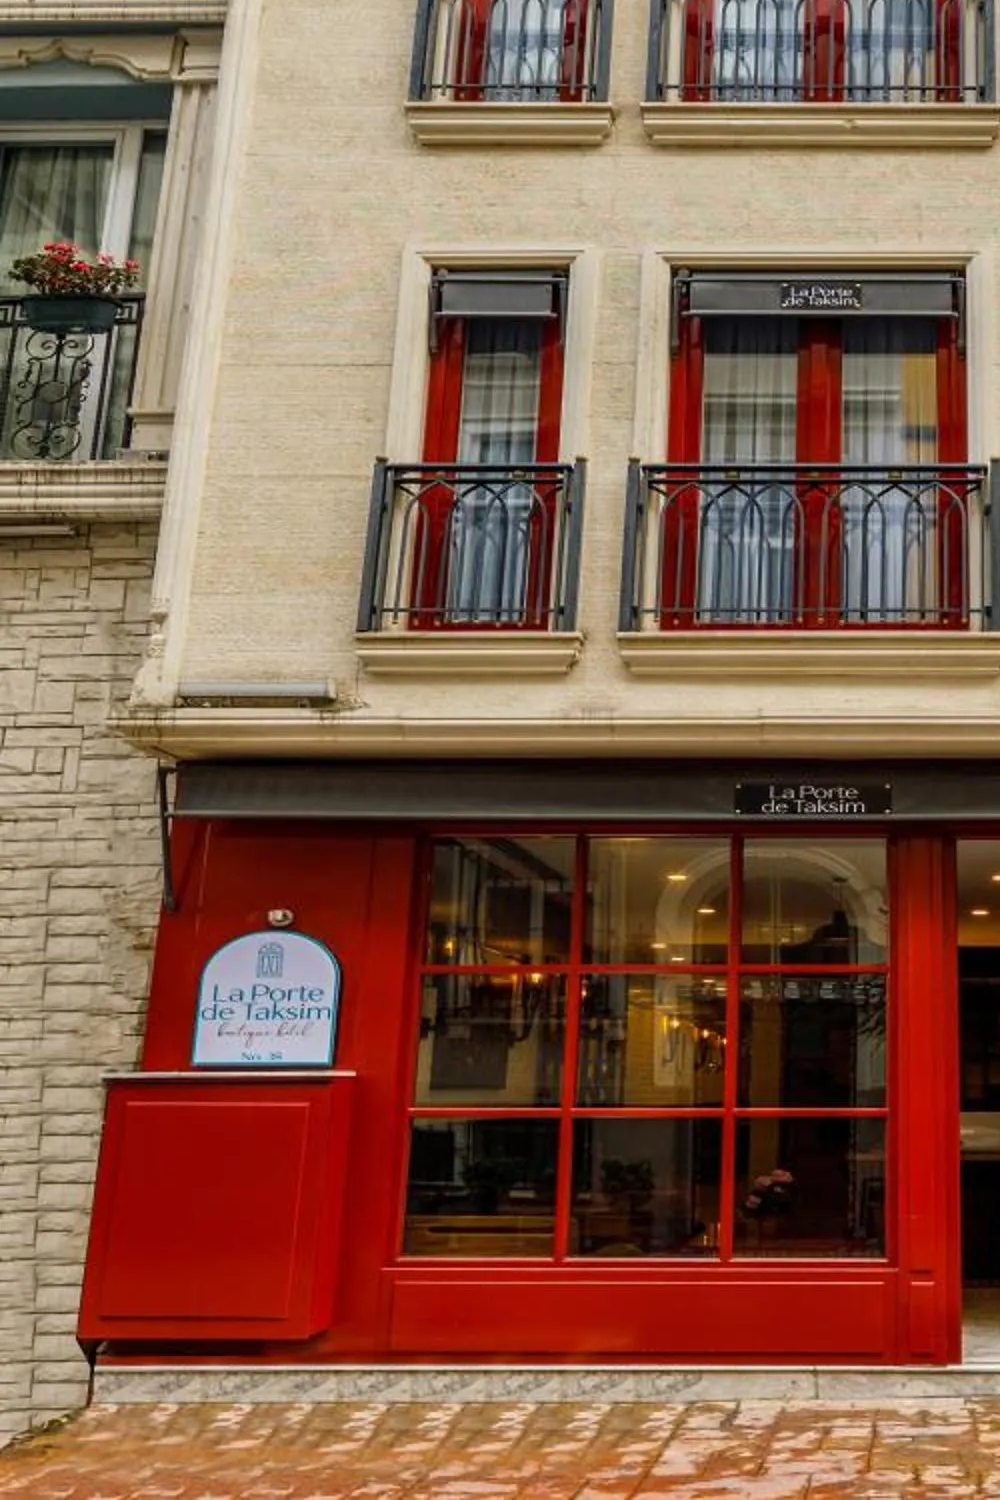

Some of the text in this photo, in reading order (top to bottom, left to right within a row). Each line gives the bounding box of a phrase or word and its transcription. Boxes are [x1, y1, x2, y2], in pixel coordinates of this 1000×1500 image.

[769, 785, 860, 799] La Porte
[761, 799, 865, 813] de Taksim
[213, 983, 325, 1002] La Porte
[201, 1001, 331, 1021] de Taksim
